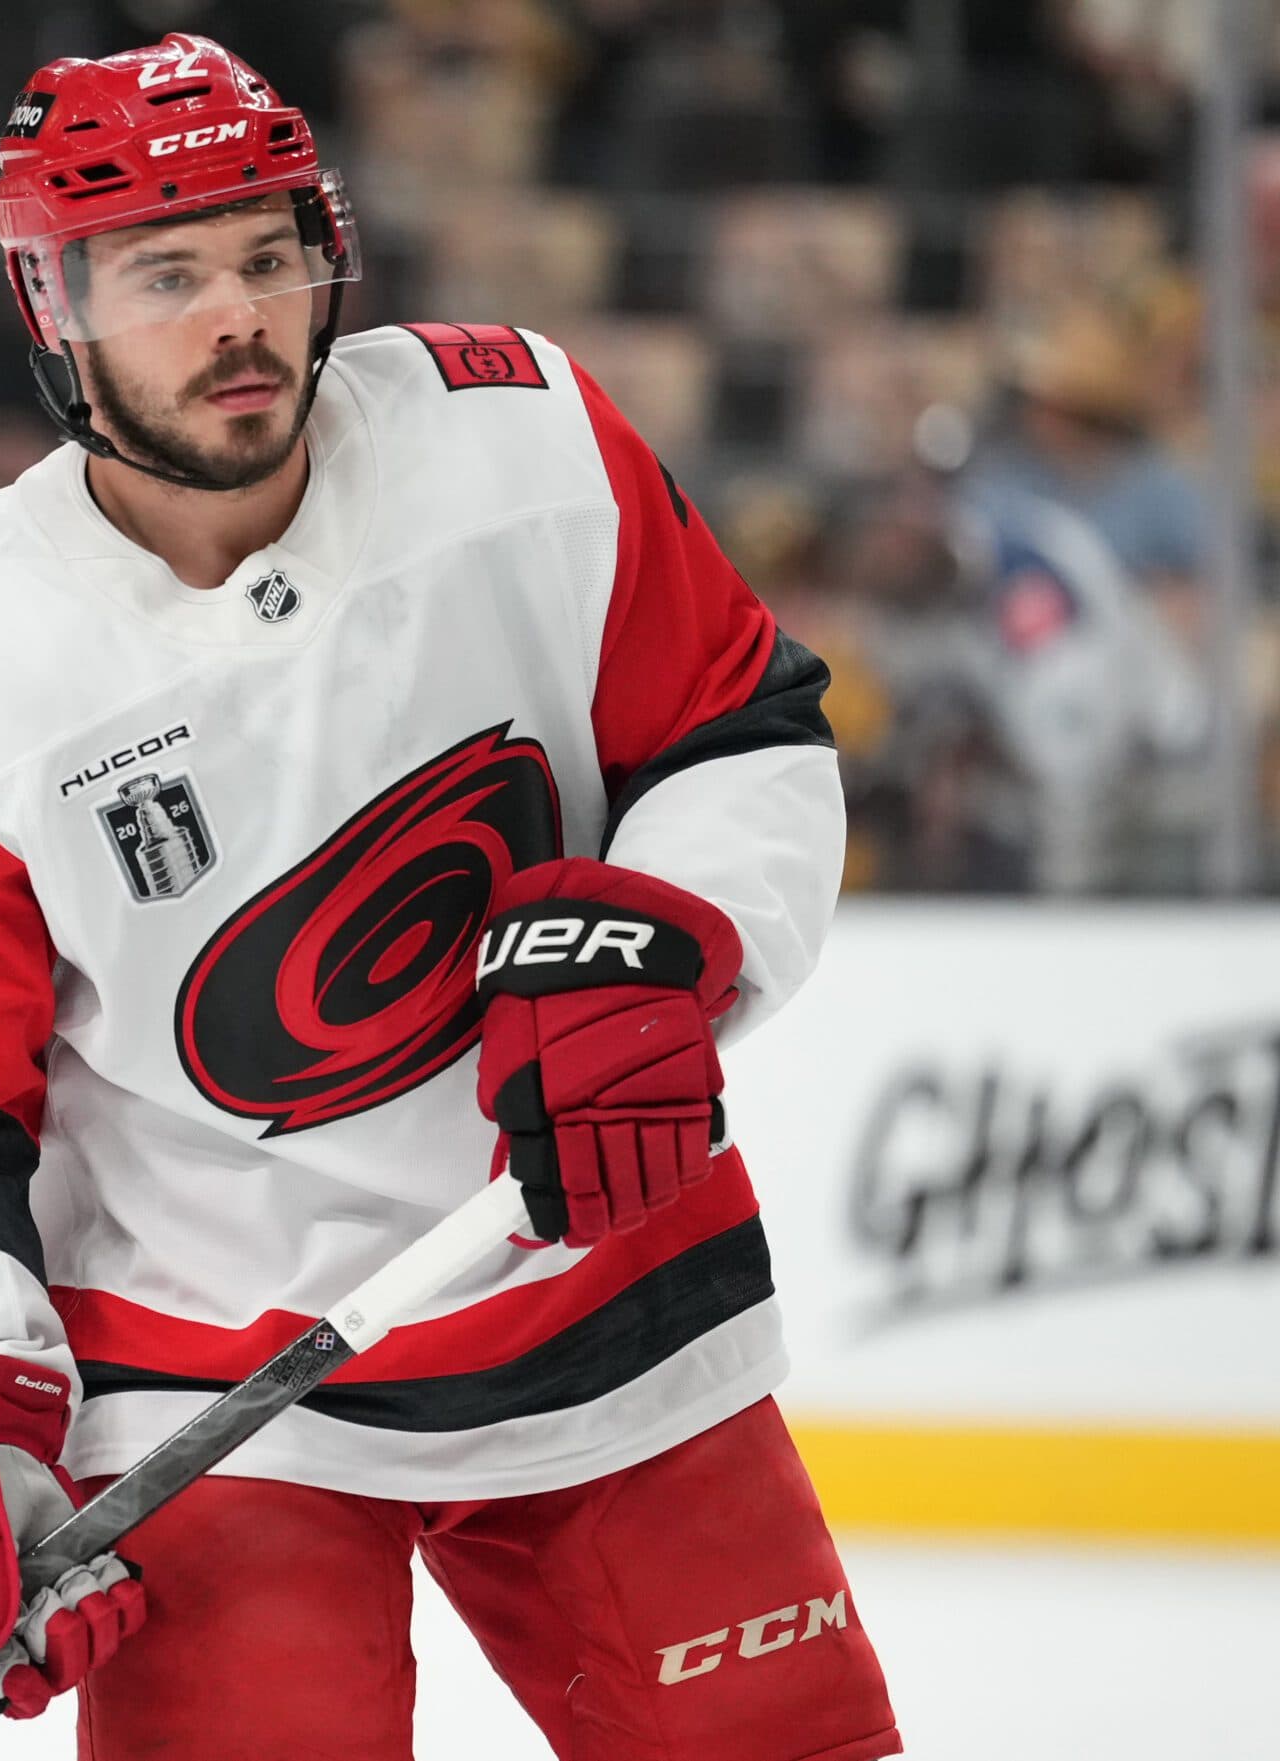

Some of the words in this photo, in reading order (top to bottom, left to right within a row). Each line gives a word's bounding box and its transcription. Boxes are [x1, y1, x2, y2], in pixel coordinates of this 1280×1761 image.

[147, 120, 248, 157] CCM
[264, 582, 285, 617] NHL
[60, 725, 190, 797] NUCOR
[116, 823, 137, 840] 20
[170, 800, 189, 818] 26
[654, 1590, 847, 1685] CCM
